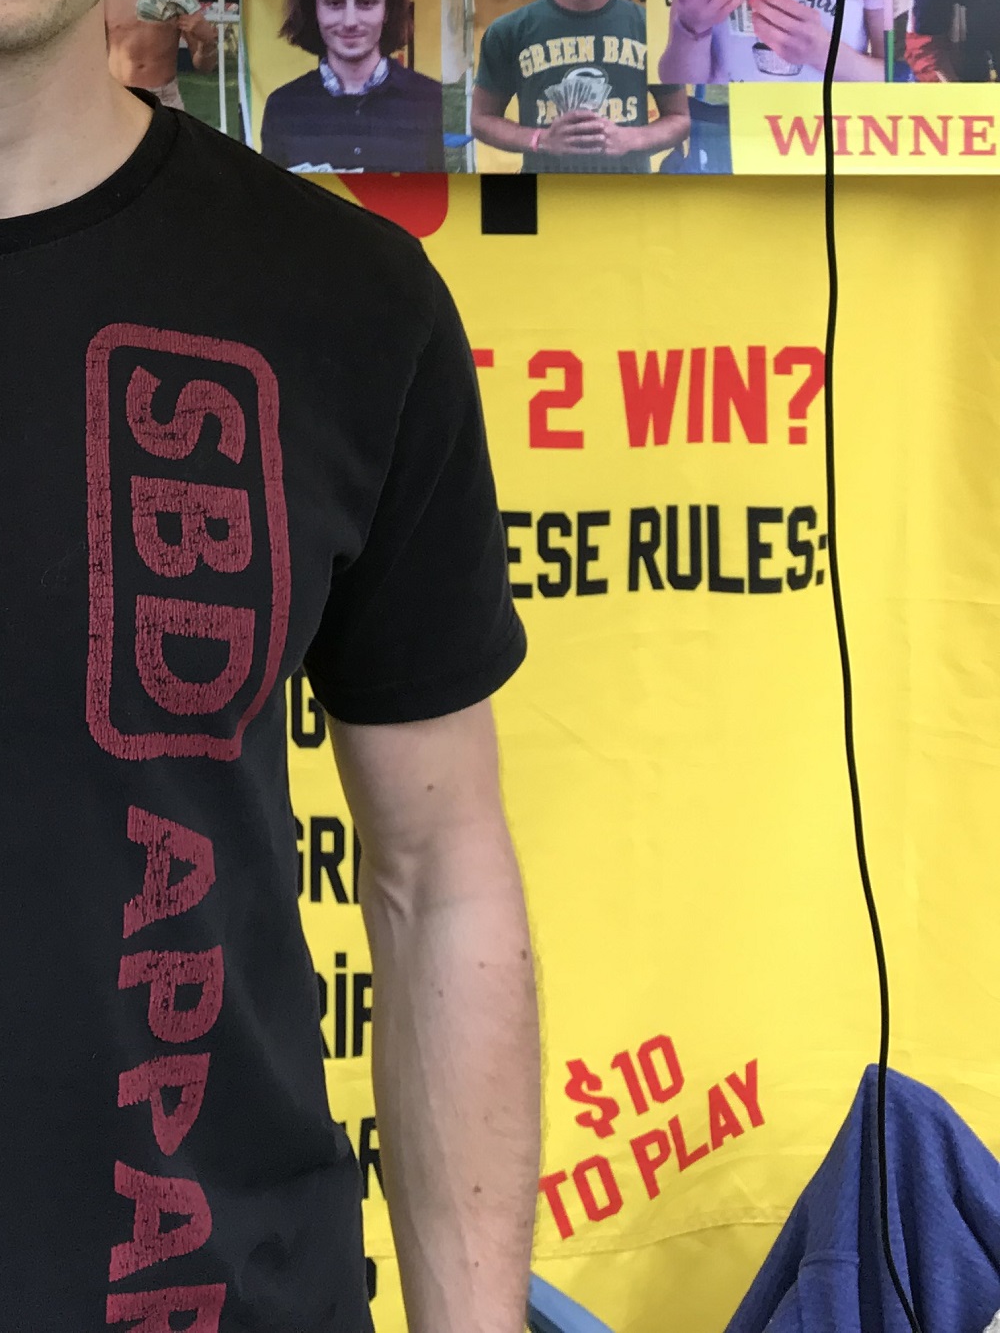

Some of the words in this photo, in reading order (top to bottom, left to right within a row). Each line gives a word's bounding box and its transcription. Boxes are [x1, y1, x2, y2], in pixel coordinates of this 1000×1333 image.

[519, 36, 596, 78] GREEN
[603, 36, 648, 71] BAY
[764, 115, 997, 156] WINNE
[527, 350, 584, 449] 2
[617, 345, 827, 448] WIN?
[125, 365, 256, 716] SBD
[499, 509, 610, 599] ESE
[627, 504, 828, 594] RULES:
[564, 1033, 685, 1140] $10
[538, 1154, 624, 1241] TO
[629, 1058, 766, 1201] PLAY
